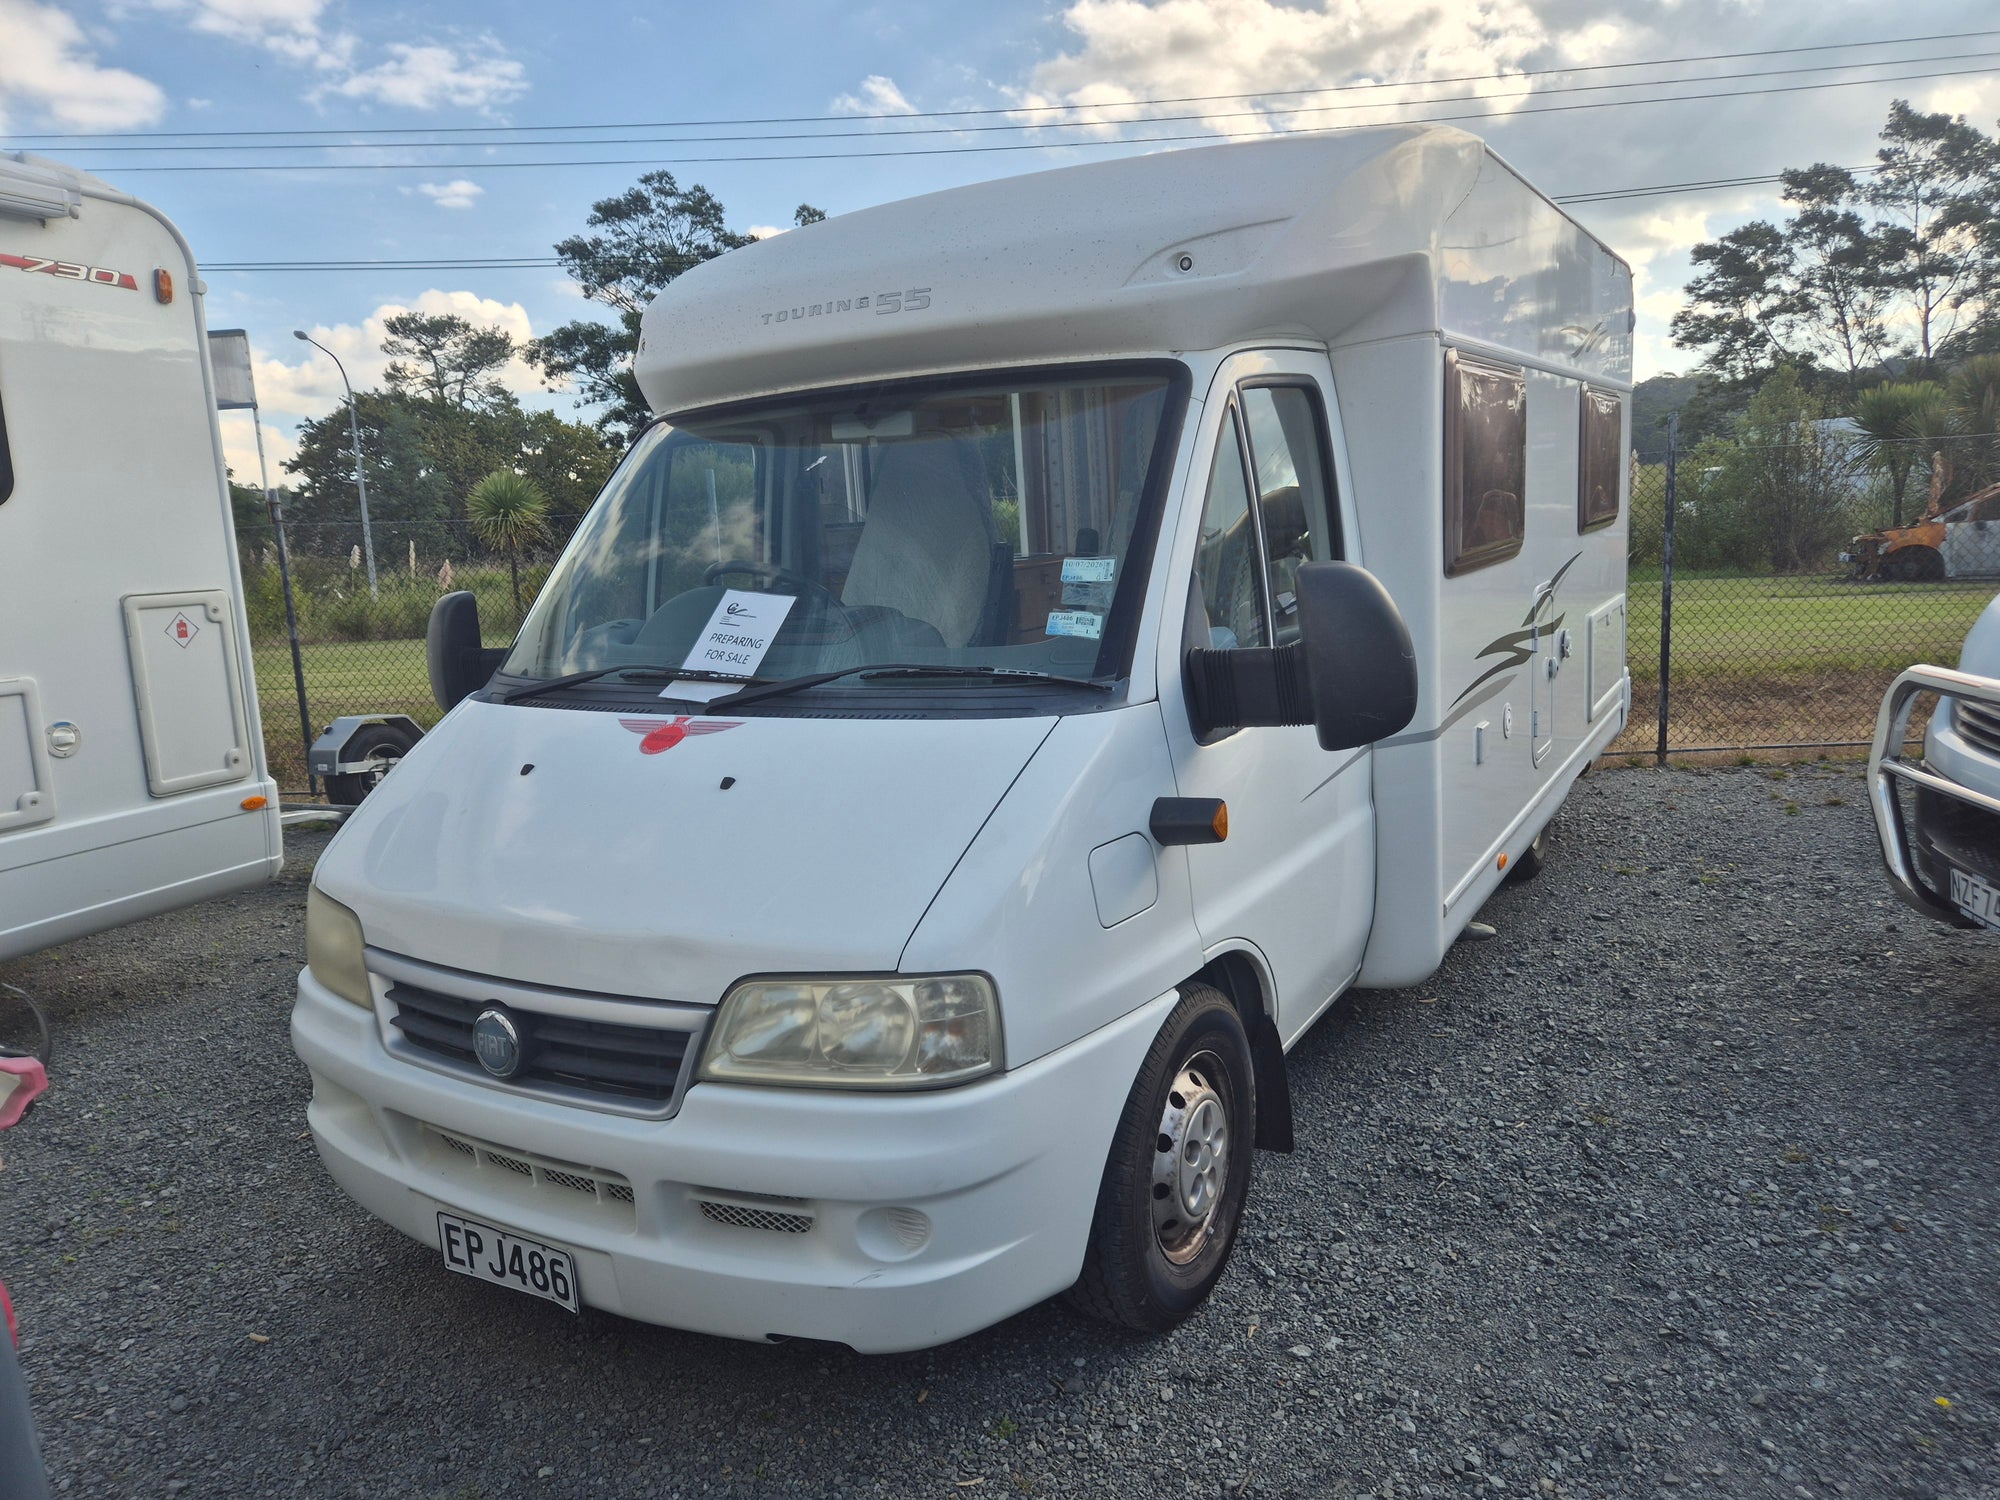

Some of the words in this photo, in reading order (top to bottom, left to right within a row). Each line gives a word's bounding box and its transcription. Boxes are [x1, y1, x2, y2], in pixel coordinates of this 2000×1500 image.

[22, 255, 120, 286] 730
[761, 297, 869, 325] TOURING
[709, 632, 764, 649] PREPARING
[704, 649, 726, 661] FOR
[725, 652, 750, 665] SALE
[478, 1033, 507, 1057] FIAT
[444, 1223, 570, 1301] EPJ486
